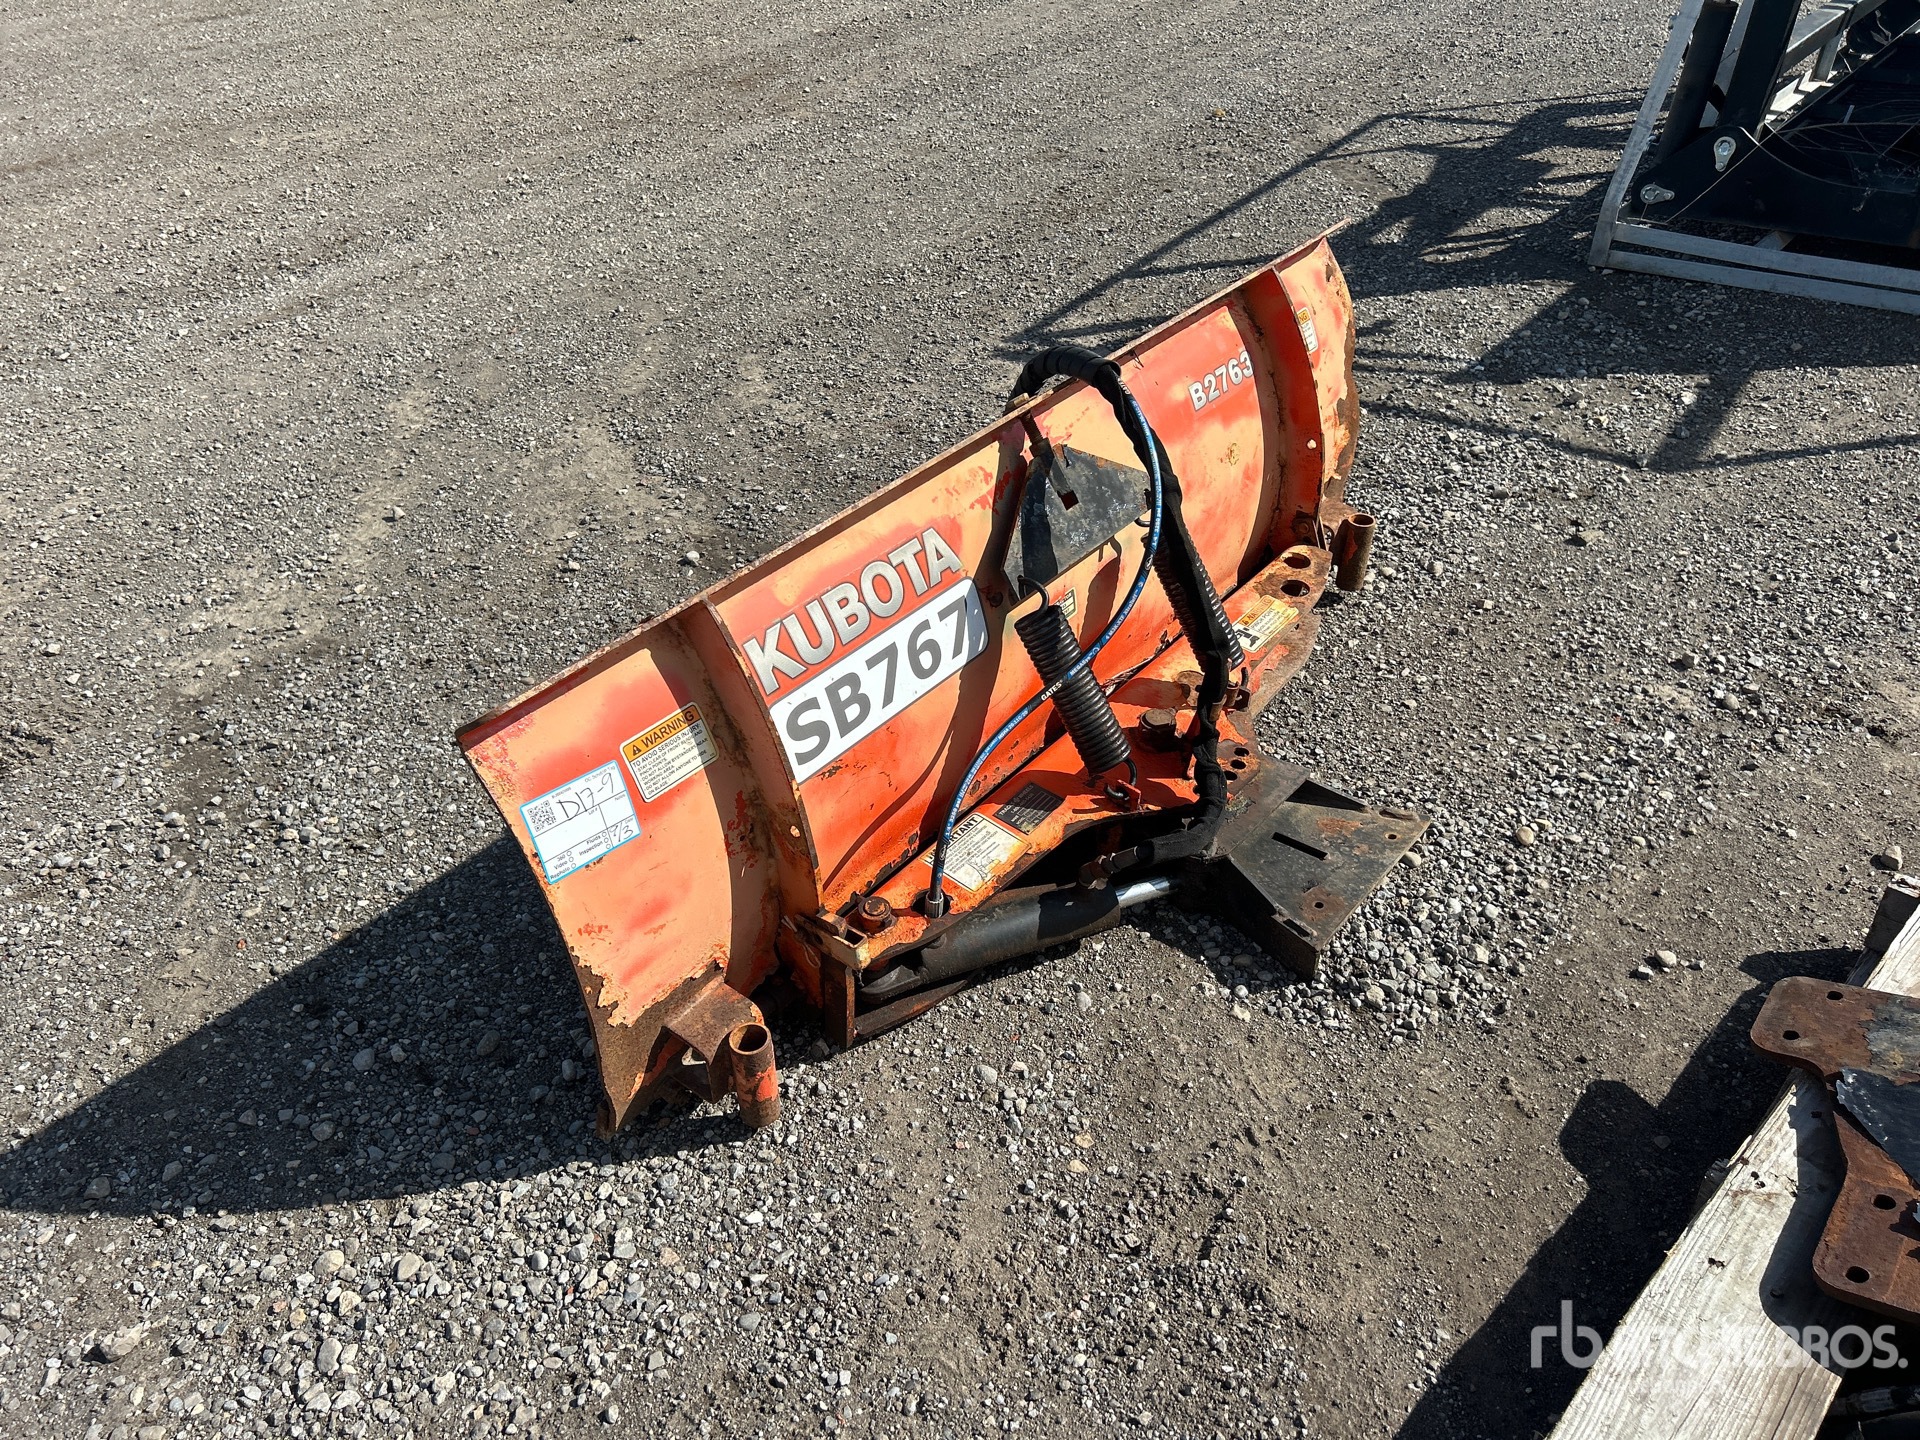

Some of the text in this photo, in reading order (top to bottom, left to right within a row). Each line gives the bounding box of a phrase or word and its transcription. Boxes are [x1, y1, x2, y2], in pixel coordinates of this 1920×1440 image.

[1188, 349, 1255, 411] B2763
[743, 527, 964, 696] KUBOTA
[785, 594, 967, 766] SB767
[639, 748, 657, 763] AVOID
[657, 734, 681, 752] SERIOUS
[640, 710, 695, 749] WARNING
